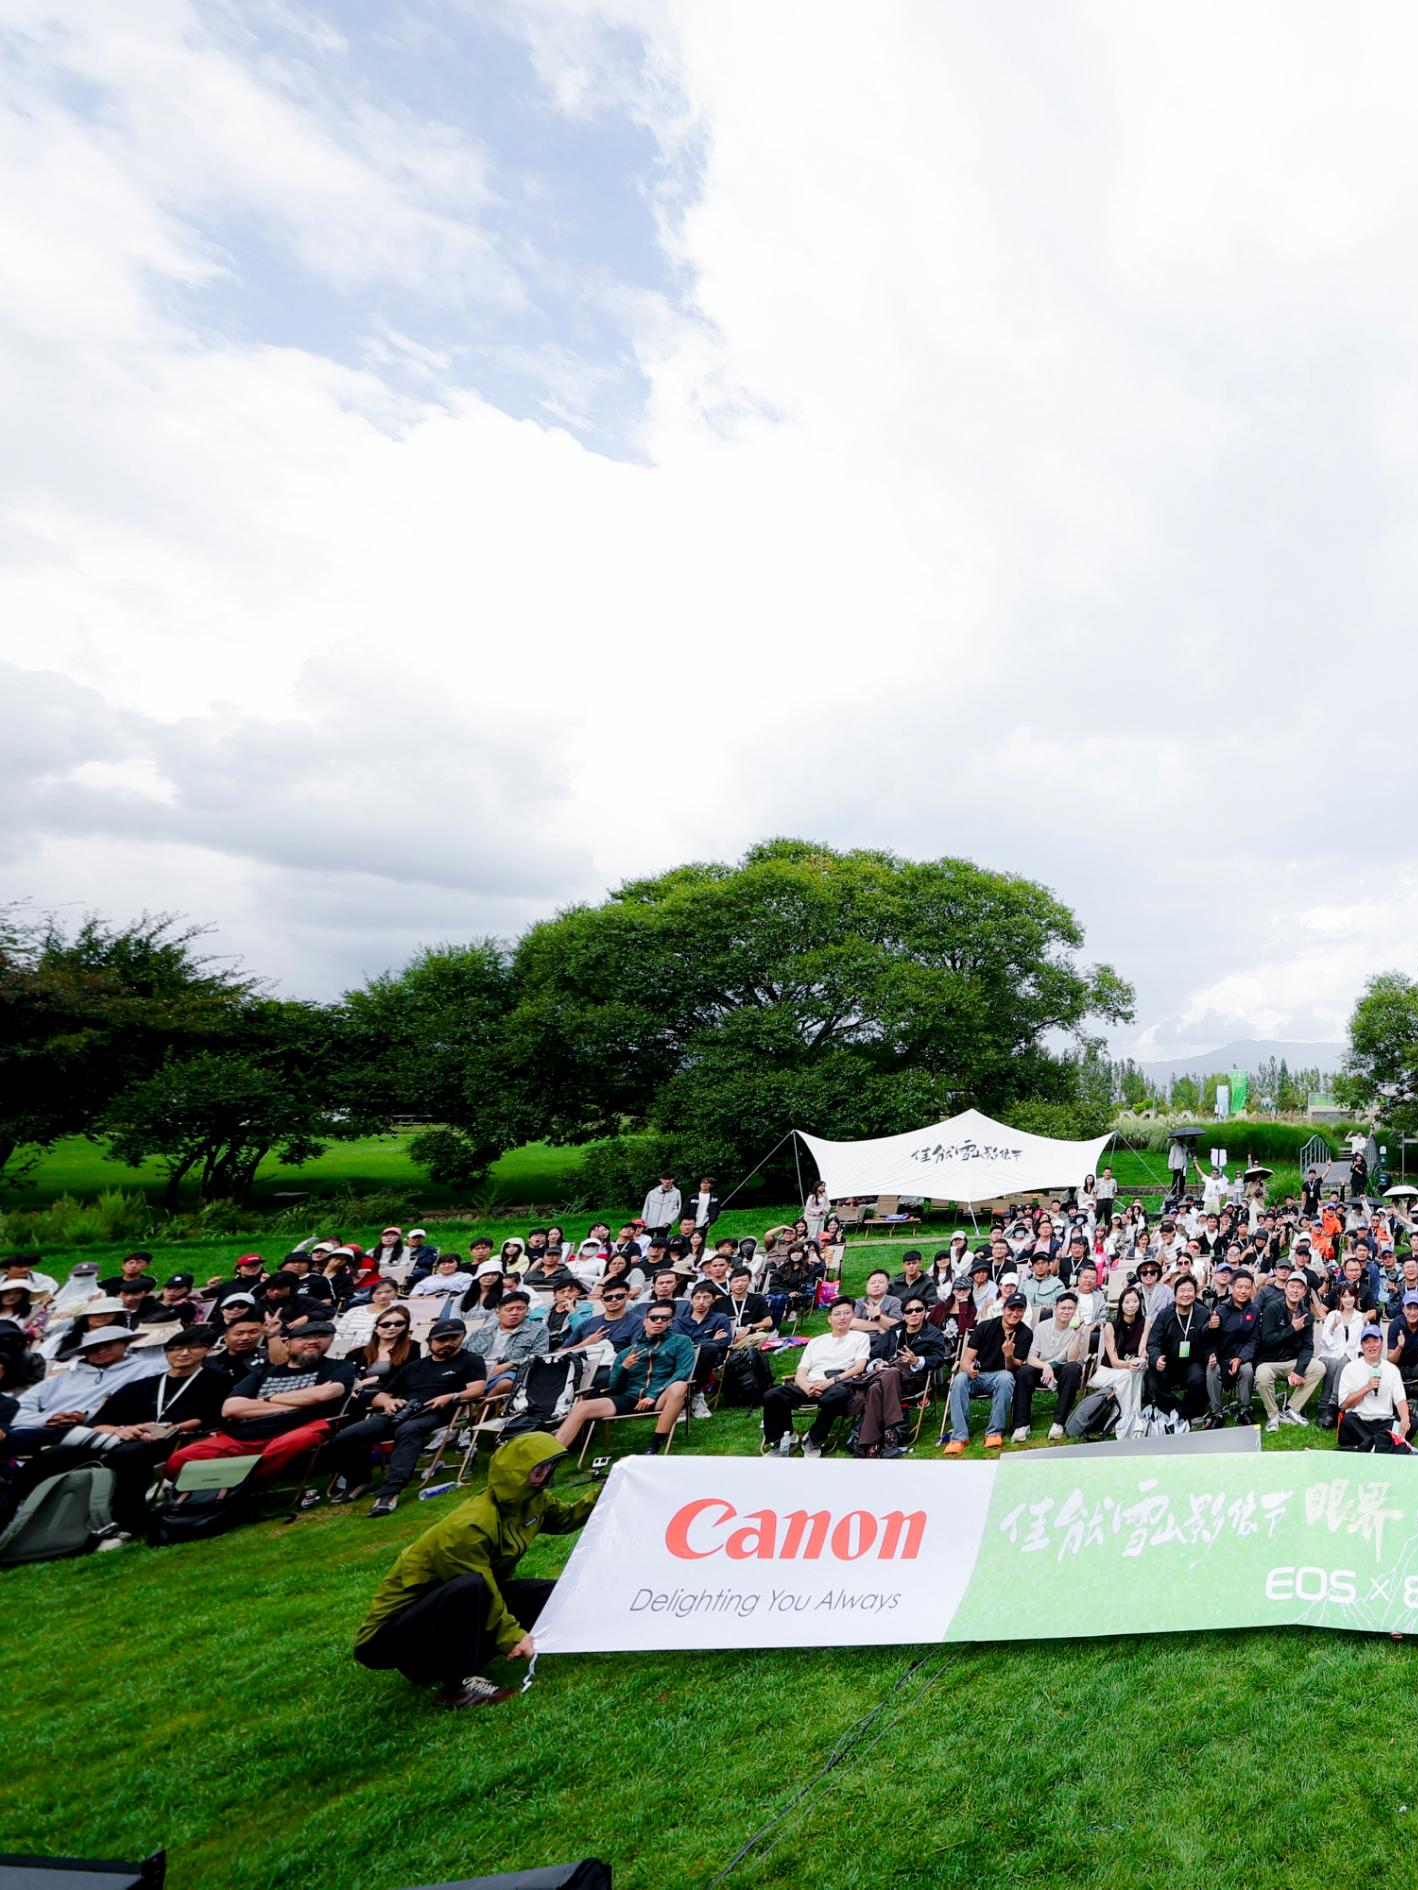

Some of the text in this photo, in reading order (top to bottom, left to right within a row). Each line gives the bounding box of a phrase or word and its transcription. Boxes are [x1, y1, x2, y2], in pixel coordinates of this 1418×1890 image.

[664, 1498, 928, 1561] Canon
[1305, 1478, 1404, 1563] 眼界
[629, 1588, 902, 1618] Delighting You Always
[1265, 1566, 1357, 1603] EOS
